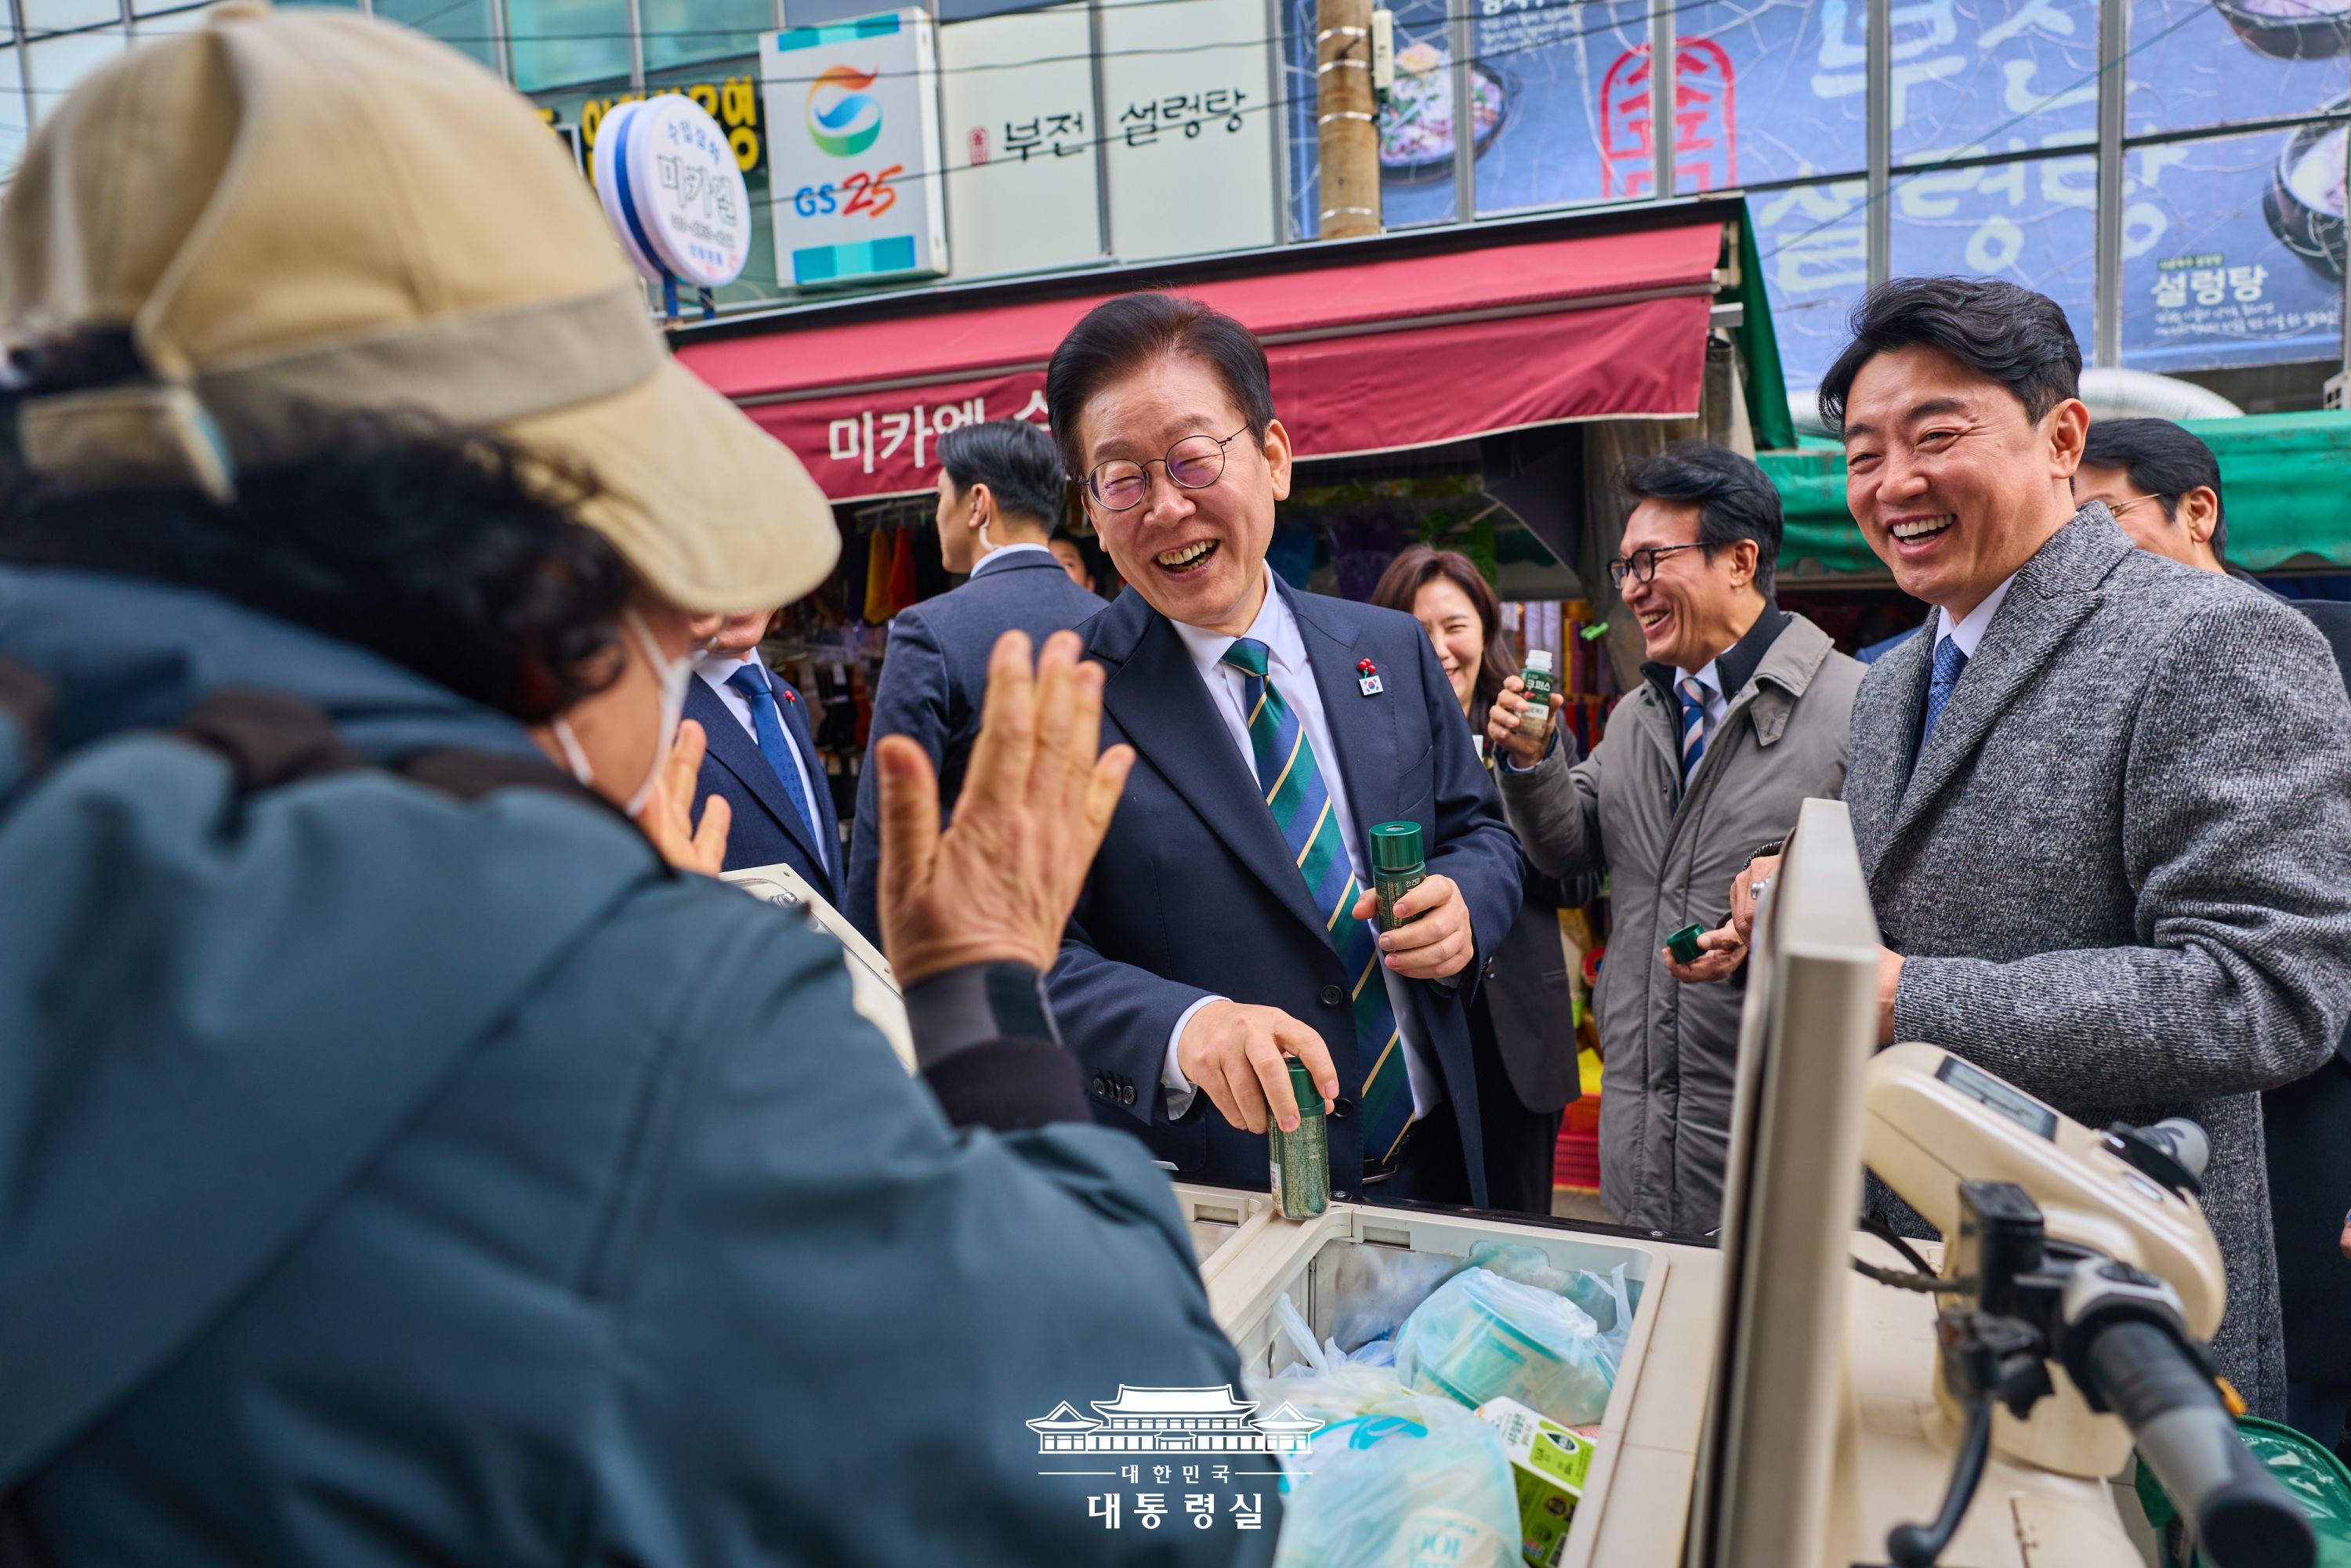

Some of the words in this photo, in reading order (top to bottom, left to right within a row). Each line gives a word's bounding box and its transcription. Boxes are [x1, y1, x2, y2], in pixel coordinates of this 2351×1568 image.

[1004, 112, 1085, 162] 부전
[1120, 88, 1248, 148] 설렁탕
[794, 163, 904, 219] GS25
[1759, 121, 2189, 294] 설렁탕
[2150, 263, 2269, 308] 설렁탕
